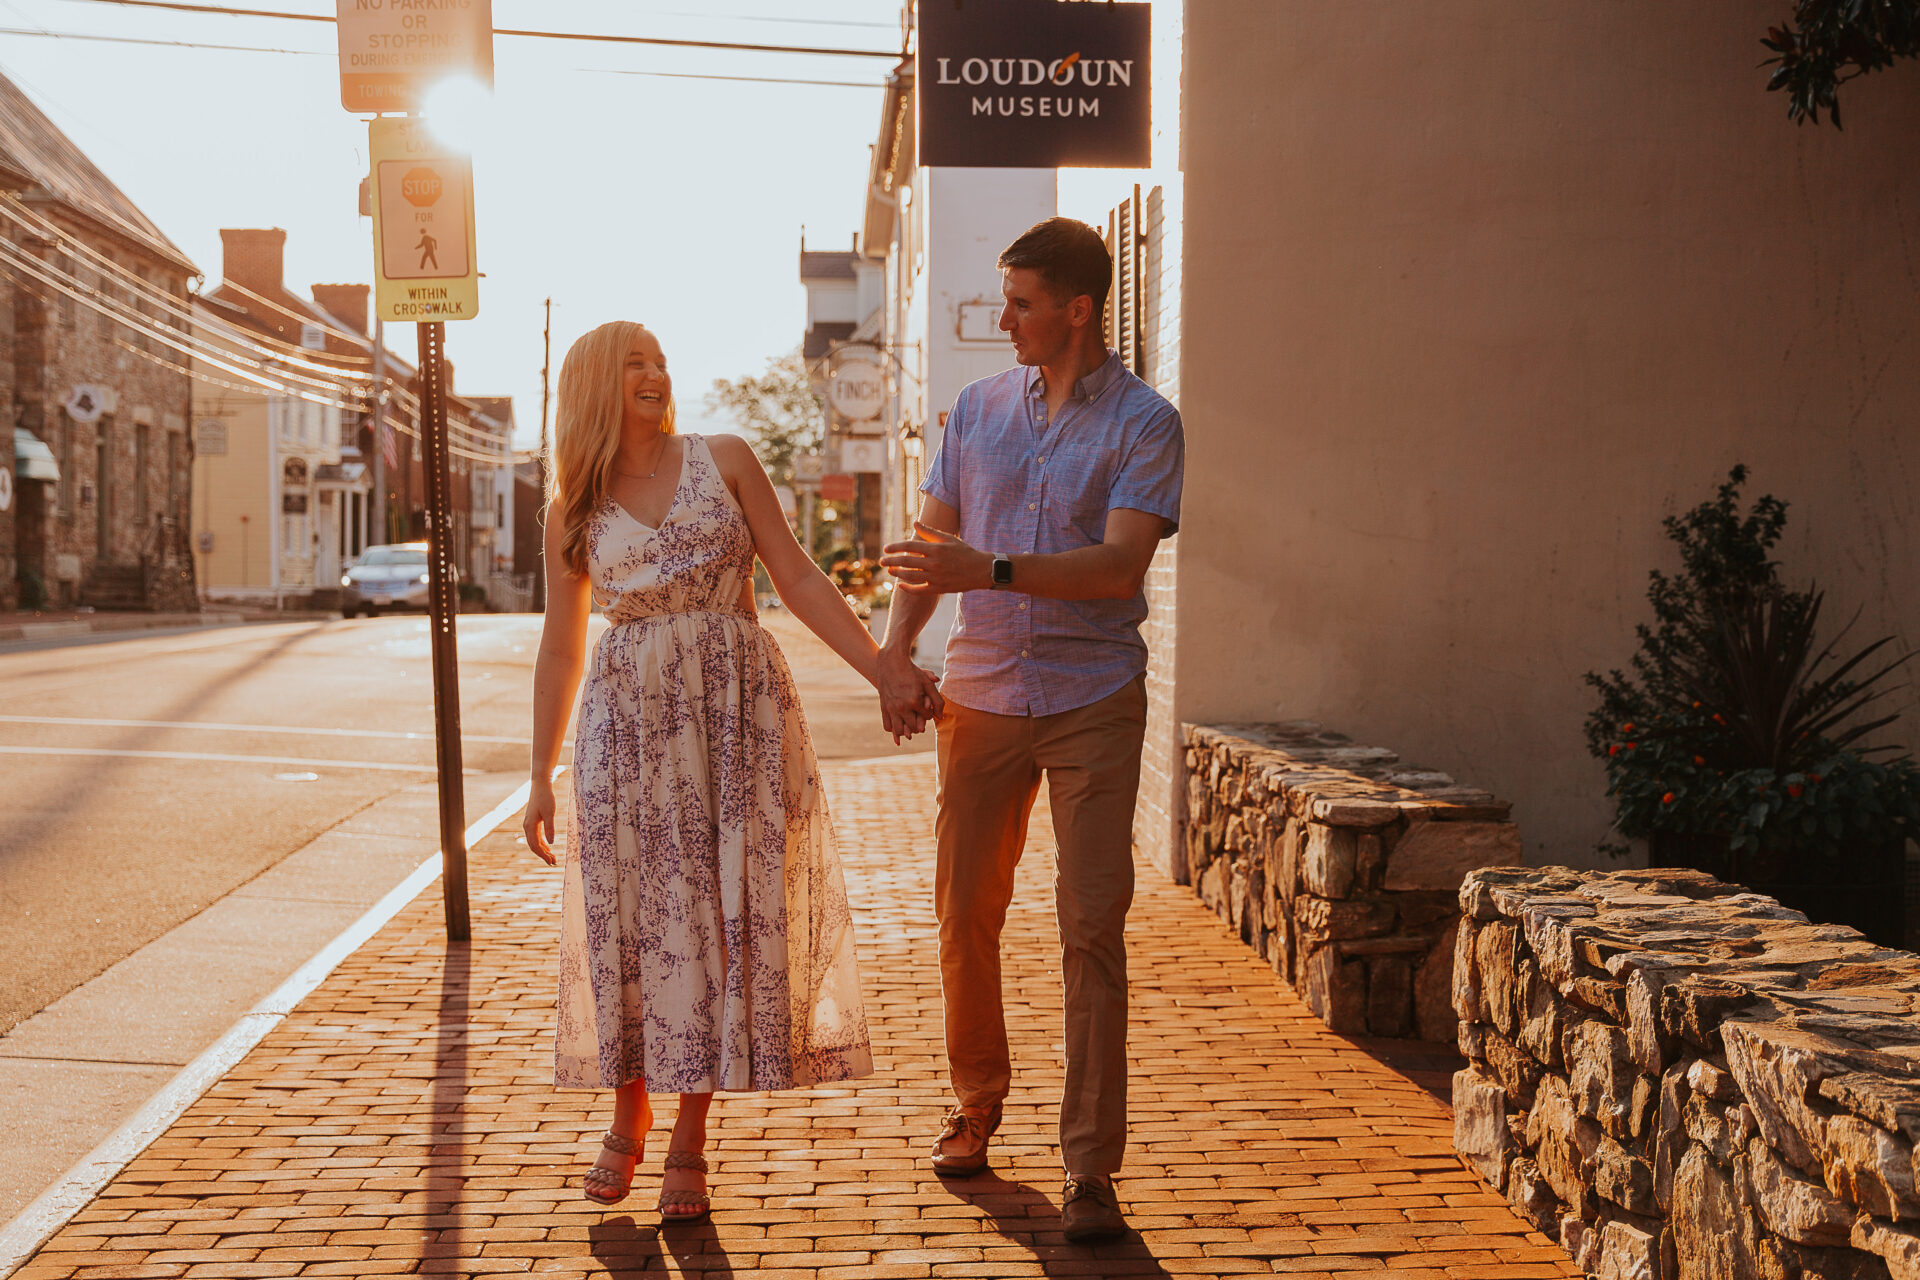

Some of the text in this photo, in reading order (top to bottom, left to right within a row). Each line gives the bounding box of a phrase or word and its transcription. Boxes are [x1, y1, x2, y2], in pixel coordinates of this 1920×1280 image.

[355, 0, 471, 10] NO PARKING
[401, 15, 427, 29] OR
[368, 33, 464, 49] STOPPING
[351, 53, 399, 66] DURING
[936, 57, 1134, 87] LOUDOUN
[971, 97, 1100, 117] MUSEUM
[403, 179, 440, 196] STOP
[415, 212, 434, 223] FOR
[407, 287, 448, 300] WITHIN
[393, 301, 463, 316] CROSWALK
[836, 380, 881, 400] FINCH
